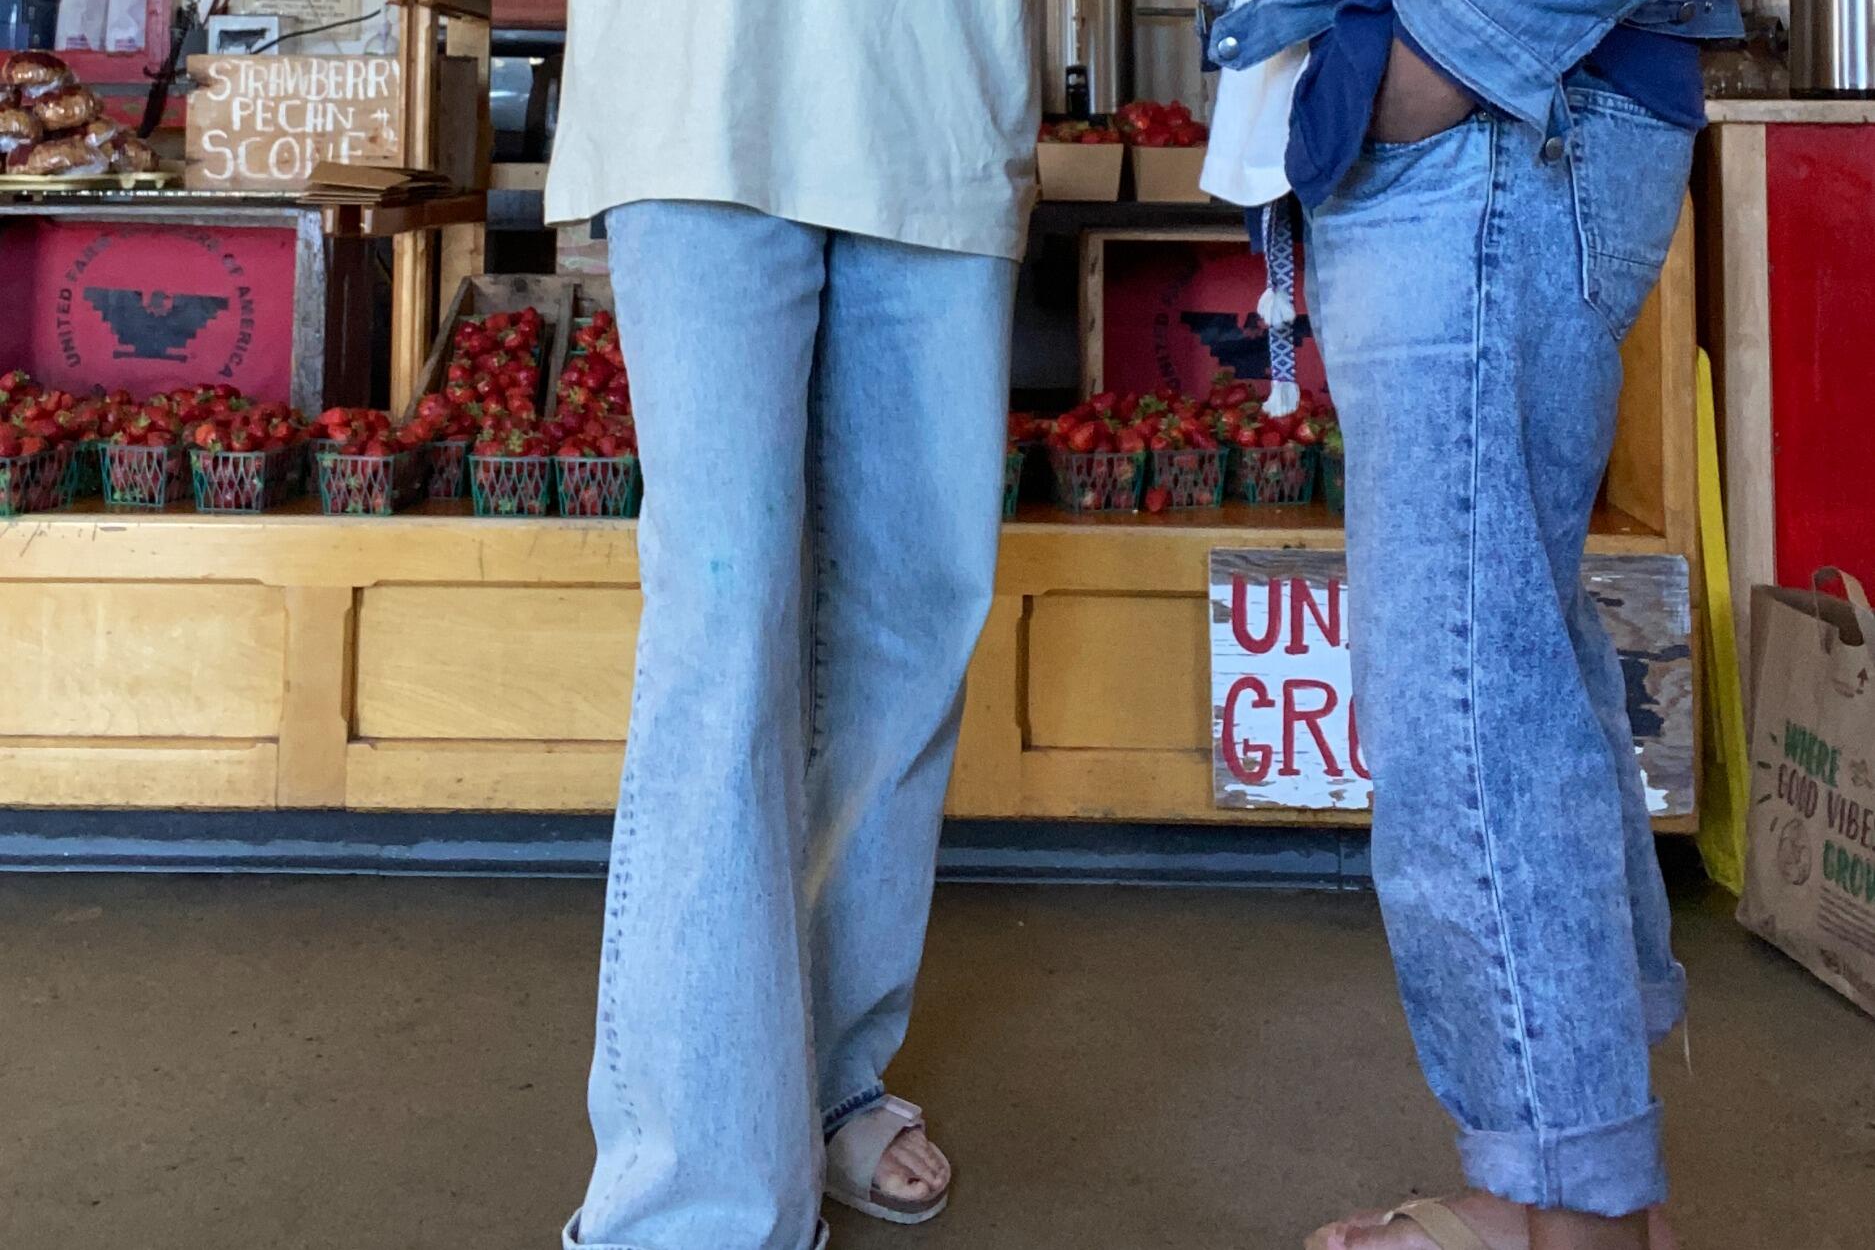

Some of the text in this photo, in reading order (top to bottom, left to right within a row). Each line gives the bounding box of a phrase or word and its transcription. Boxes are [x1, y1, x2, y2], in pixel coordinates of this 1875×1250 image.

[231, 96, 356, 134] PECAN
[56, 287, 82, 369] UNITED
[217, 285, 256, 379] AMERICA
[1231, 573, 1350, 655] UN
[1783, 718, 1842, 789] WHERE
[1777, 762, 1875, 851] GOOD VIBE
